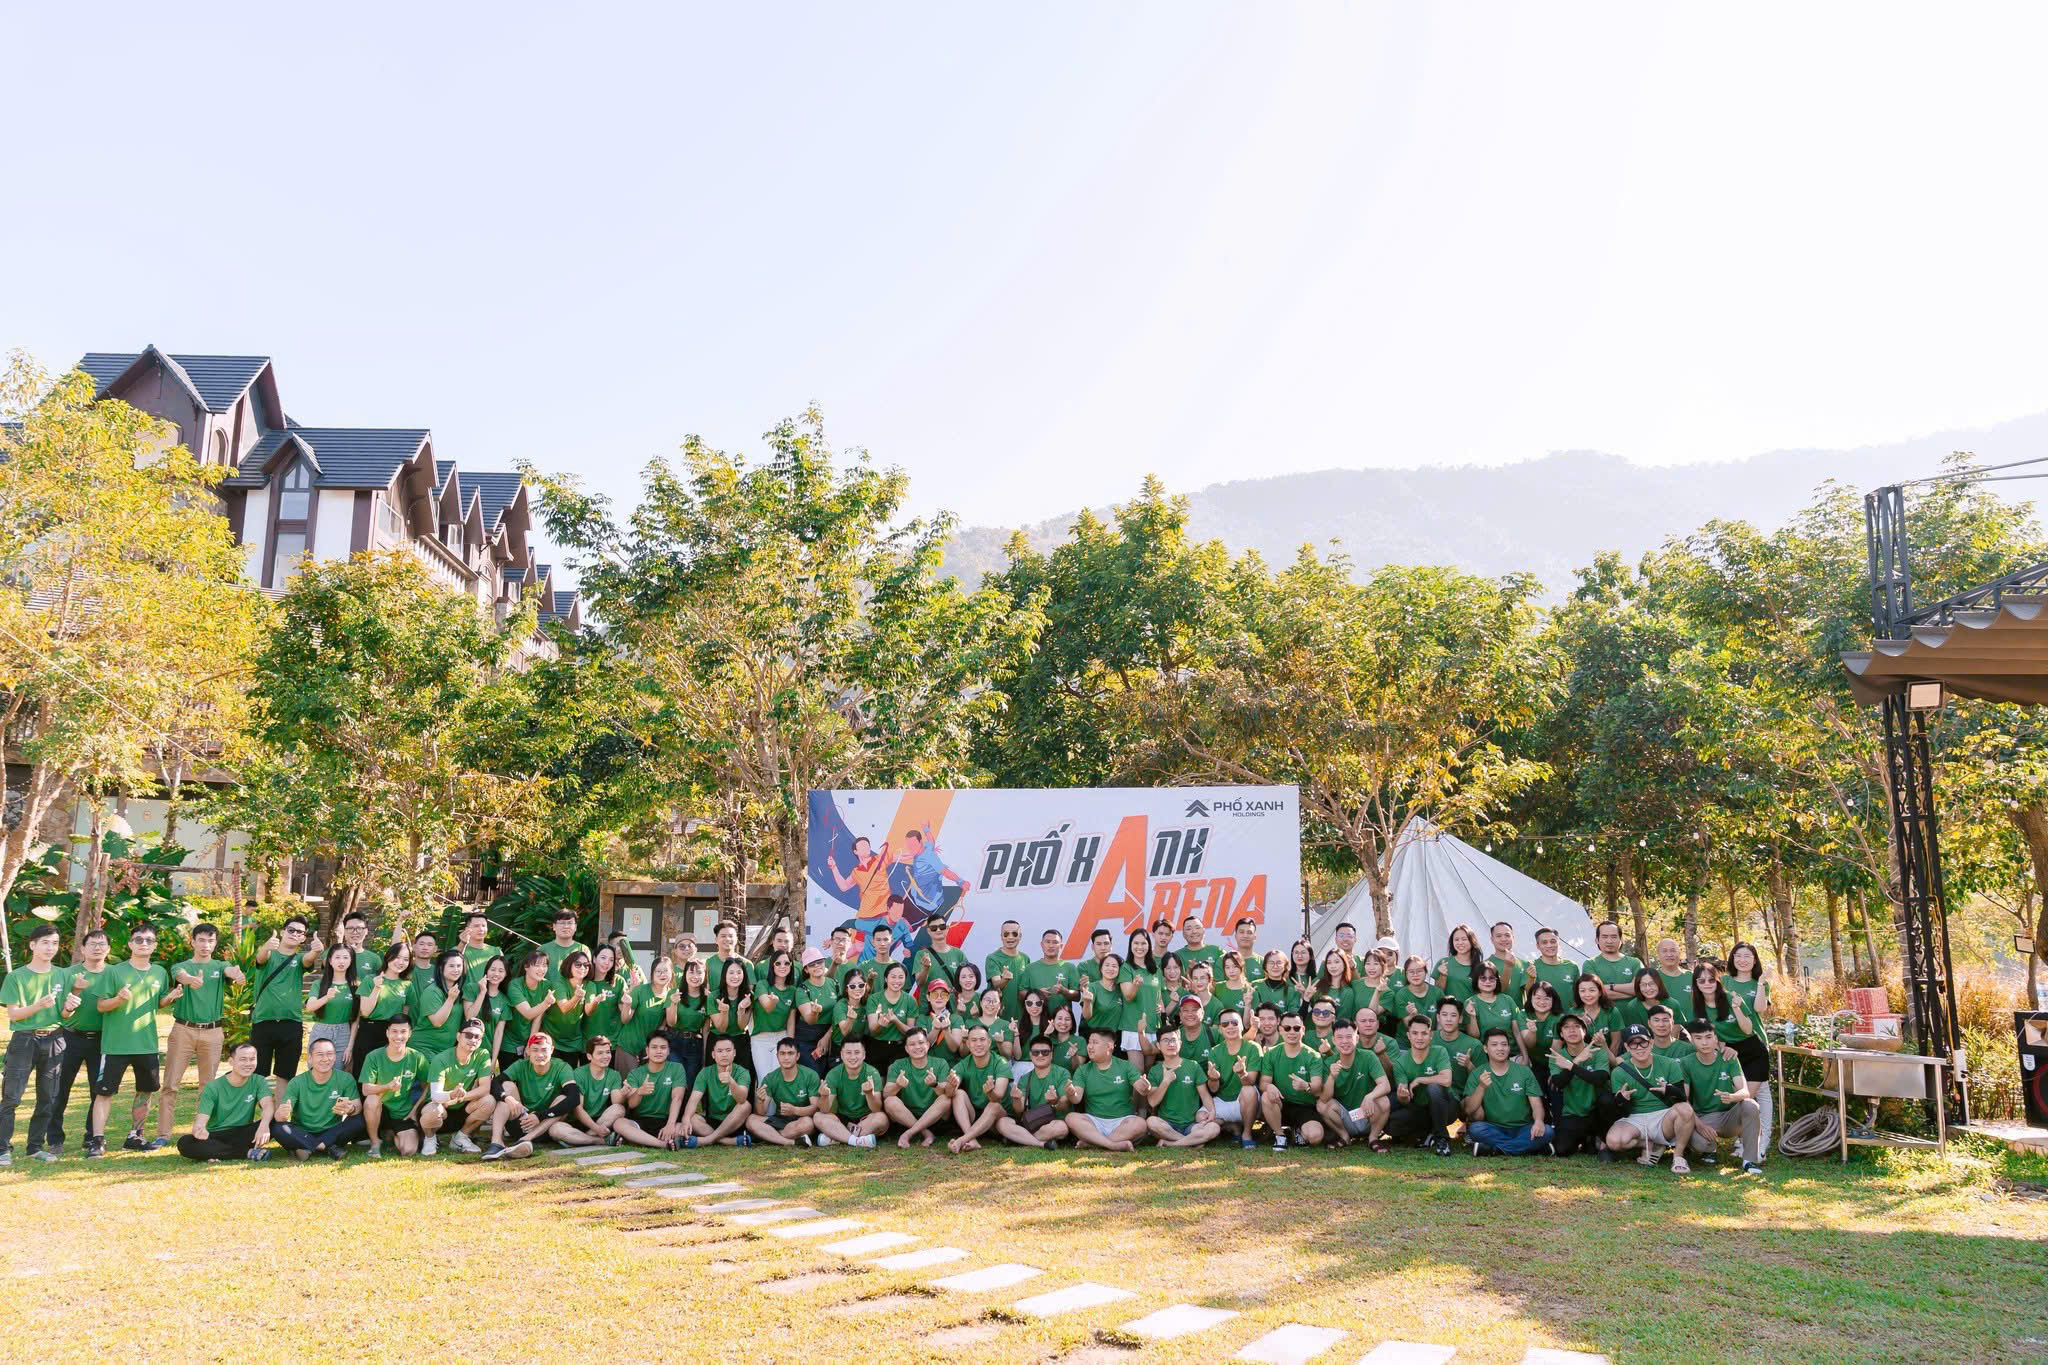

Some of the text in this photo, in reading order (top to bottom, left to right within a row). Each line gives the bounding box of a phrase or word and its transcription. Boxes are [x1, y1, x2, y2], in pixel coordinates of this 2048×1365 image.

[1213, 797, 1284, 811] PHỐ XANH
[979, 823, 1071, 890] PHỐ
